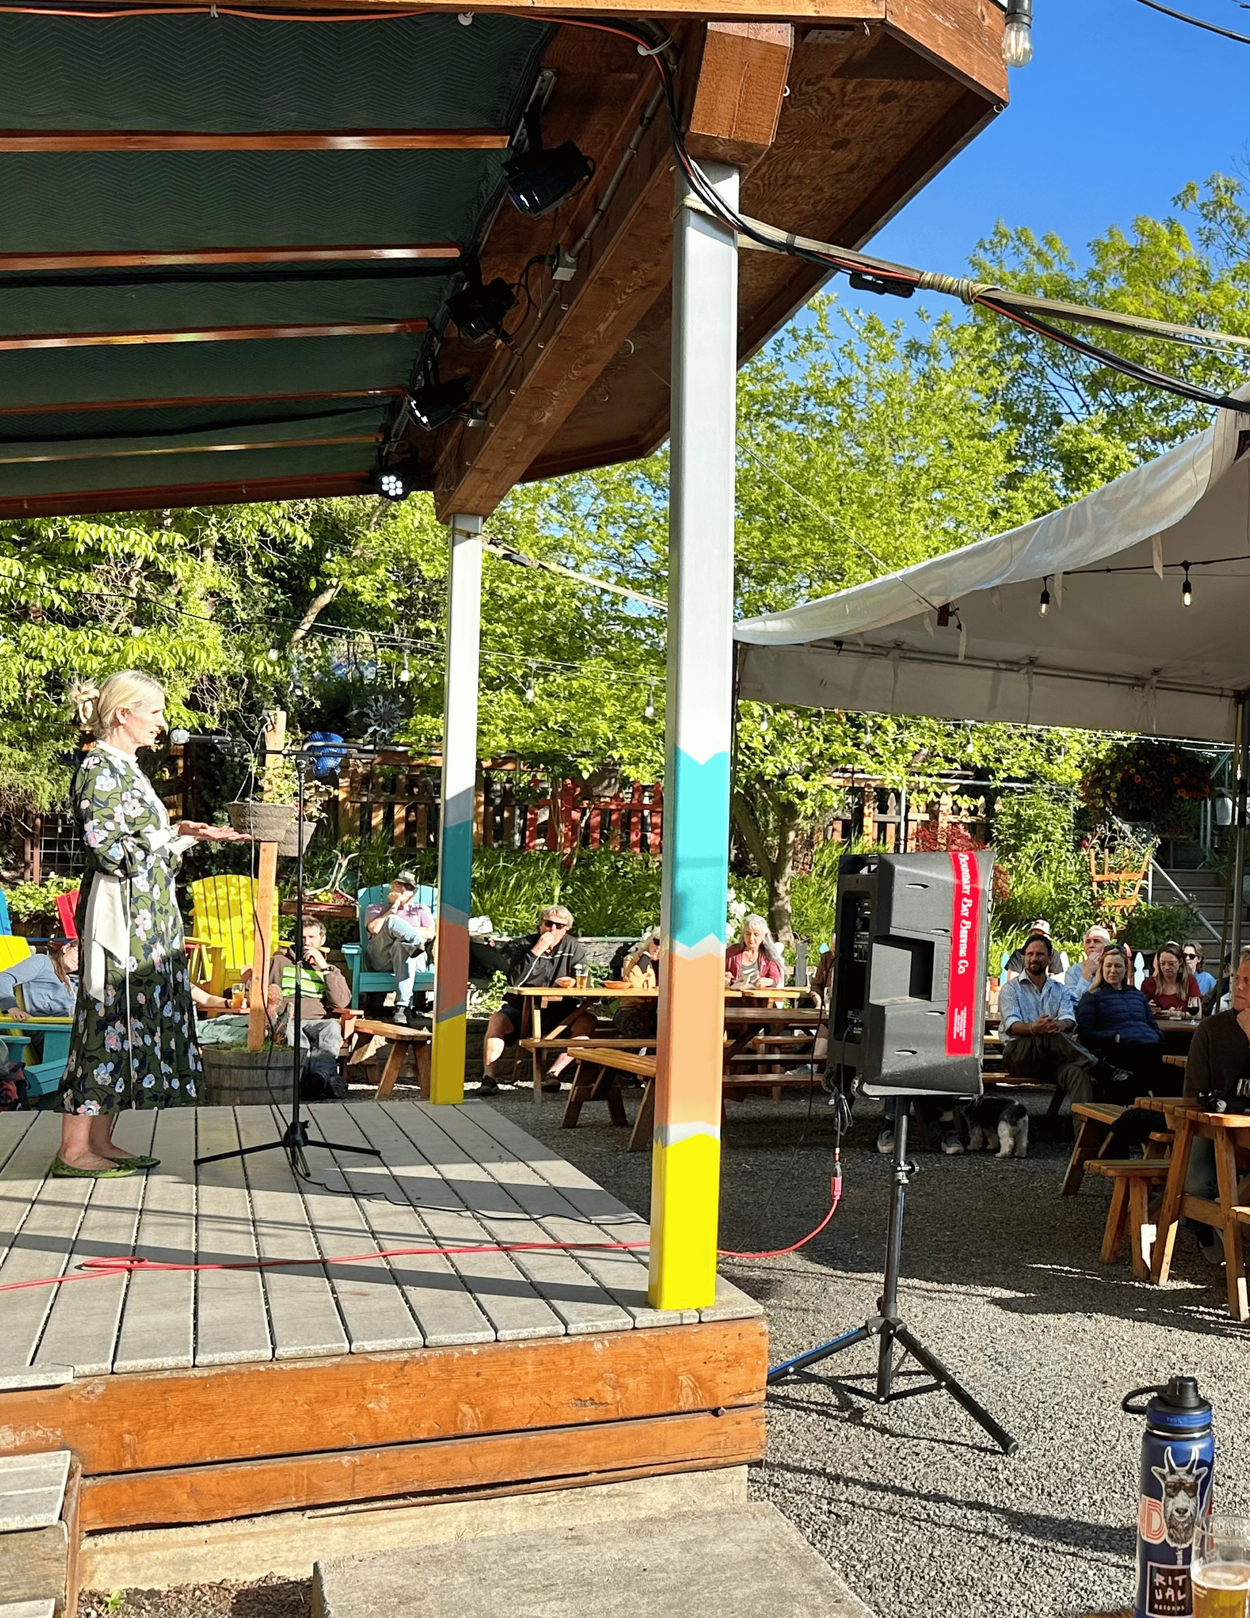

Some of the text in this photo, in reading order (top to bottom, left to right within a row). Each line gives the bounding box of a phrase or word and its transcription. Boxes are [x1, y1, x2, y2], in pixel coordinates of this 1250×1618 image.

[960, 897, 973, 917] BAY
[1154, 1573, 1187, 1587] RIT
[1154, 1587, 1187, 1602] UAL
